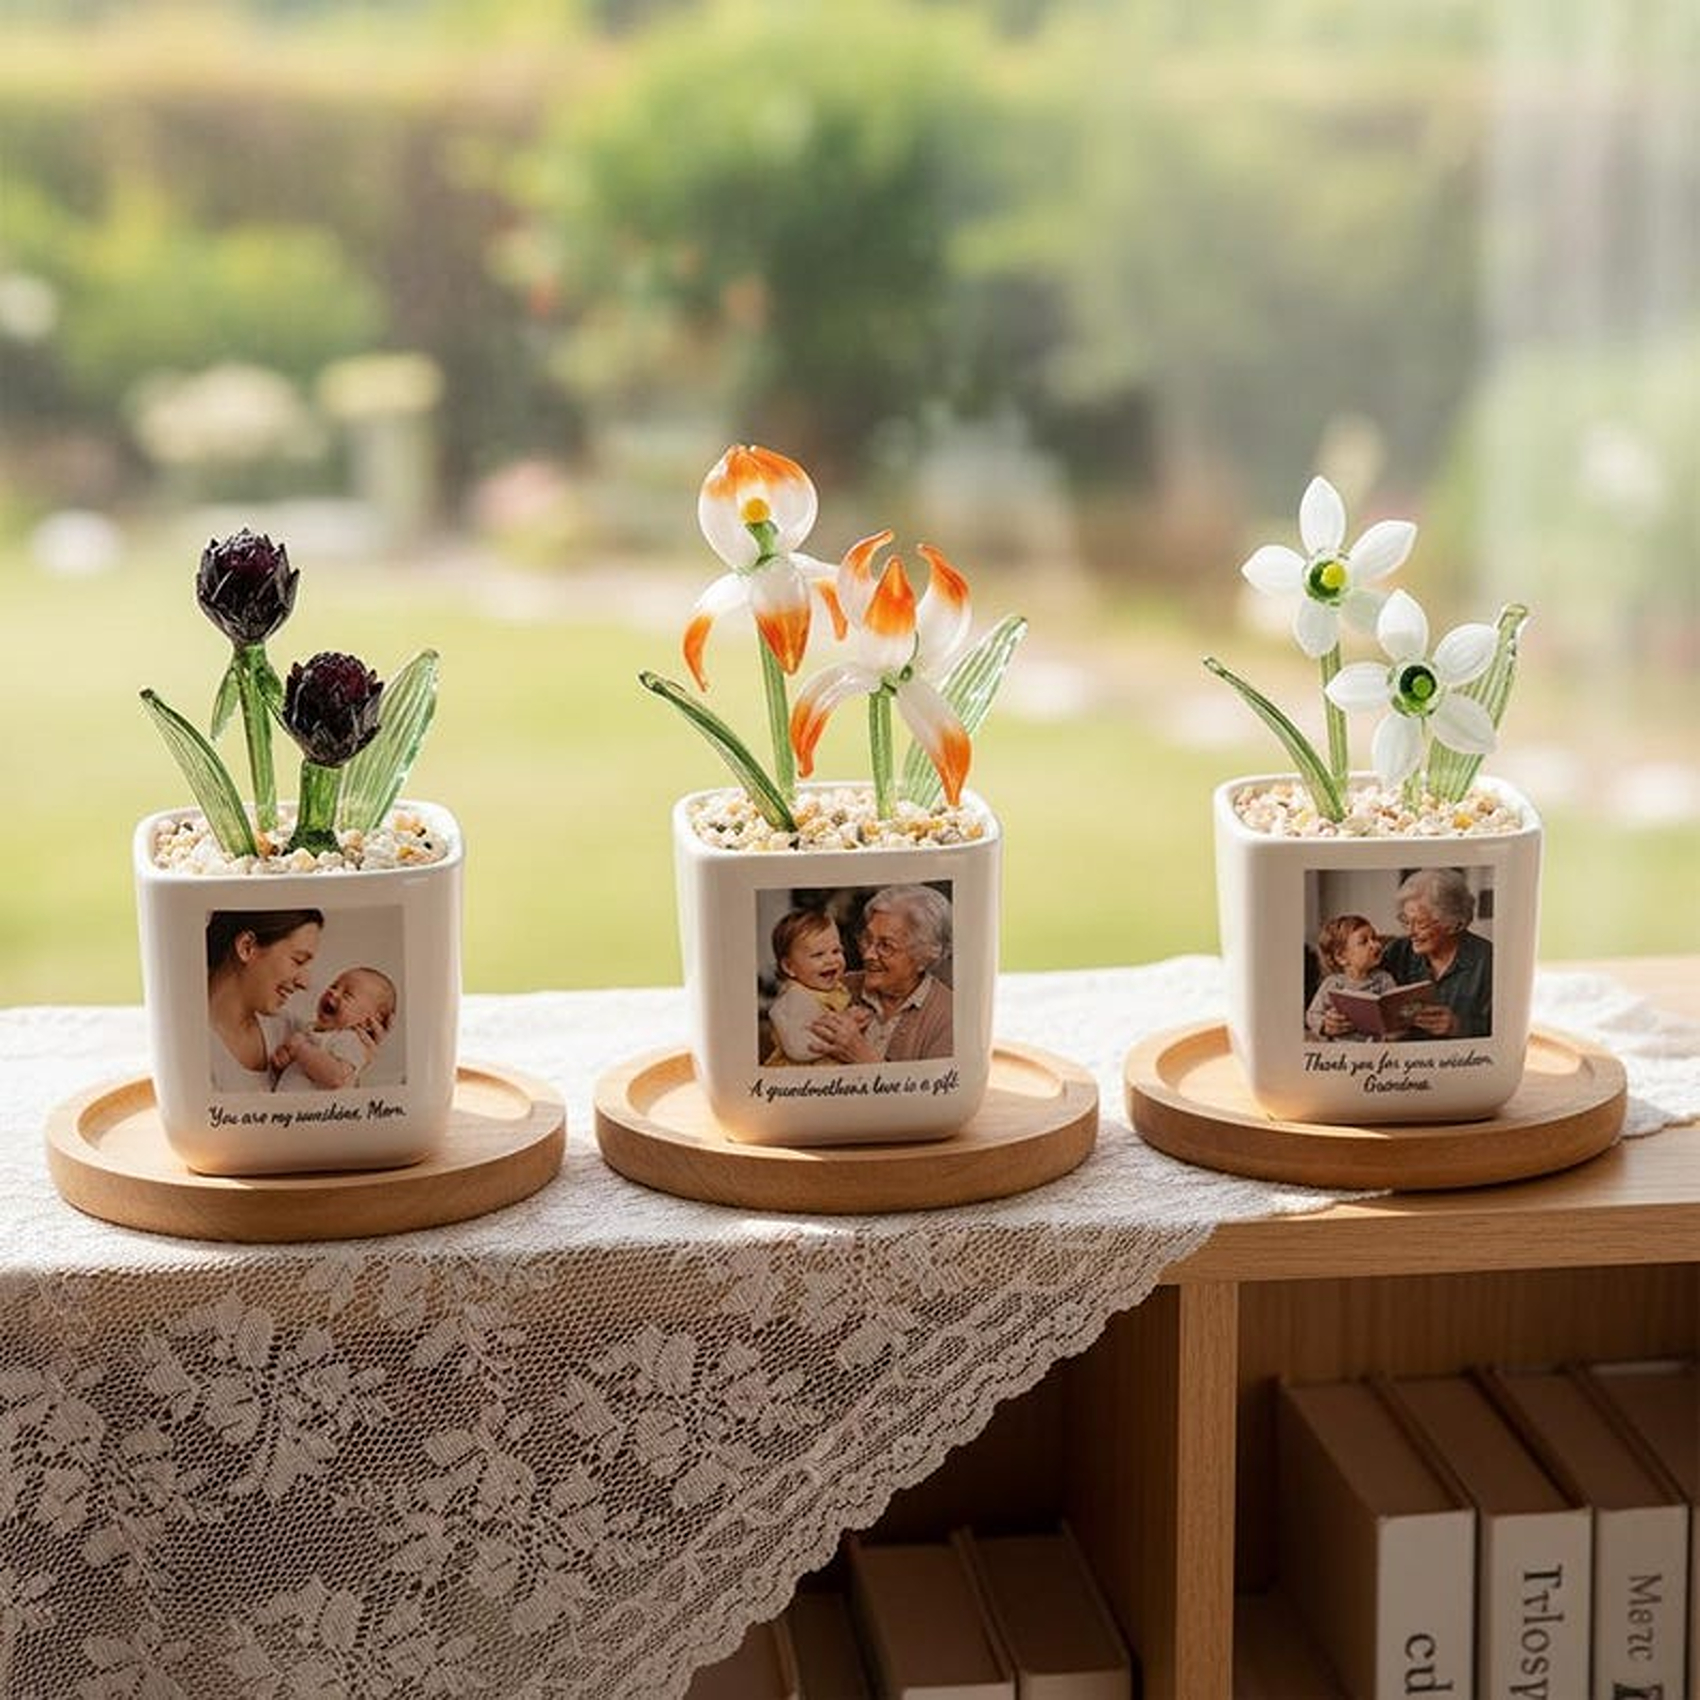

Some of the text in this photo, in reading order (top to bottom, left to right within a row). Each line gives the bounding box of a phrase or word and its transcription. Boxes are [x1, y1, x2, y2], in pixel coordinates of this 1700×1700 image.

[1304, 1052, 1346, 1071] Thank
[1350, 1060, 1374, 1076] you
[1377, 1051, 1400, 1074] for
[1403, 1059, 1434, 1074] your
[750, 1078, 762, 1097] A
[873, 1075, 899, 1093] love
[904, 1077, 916, 1093] is
[920, 1079, 930, 1091] a
[208, 1106, 239, 1127] You
[241, 1112, 267, 1125] are
[271, 1113, 293, 1128] my
